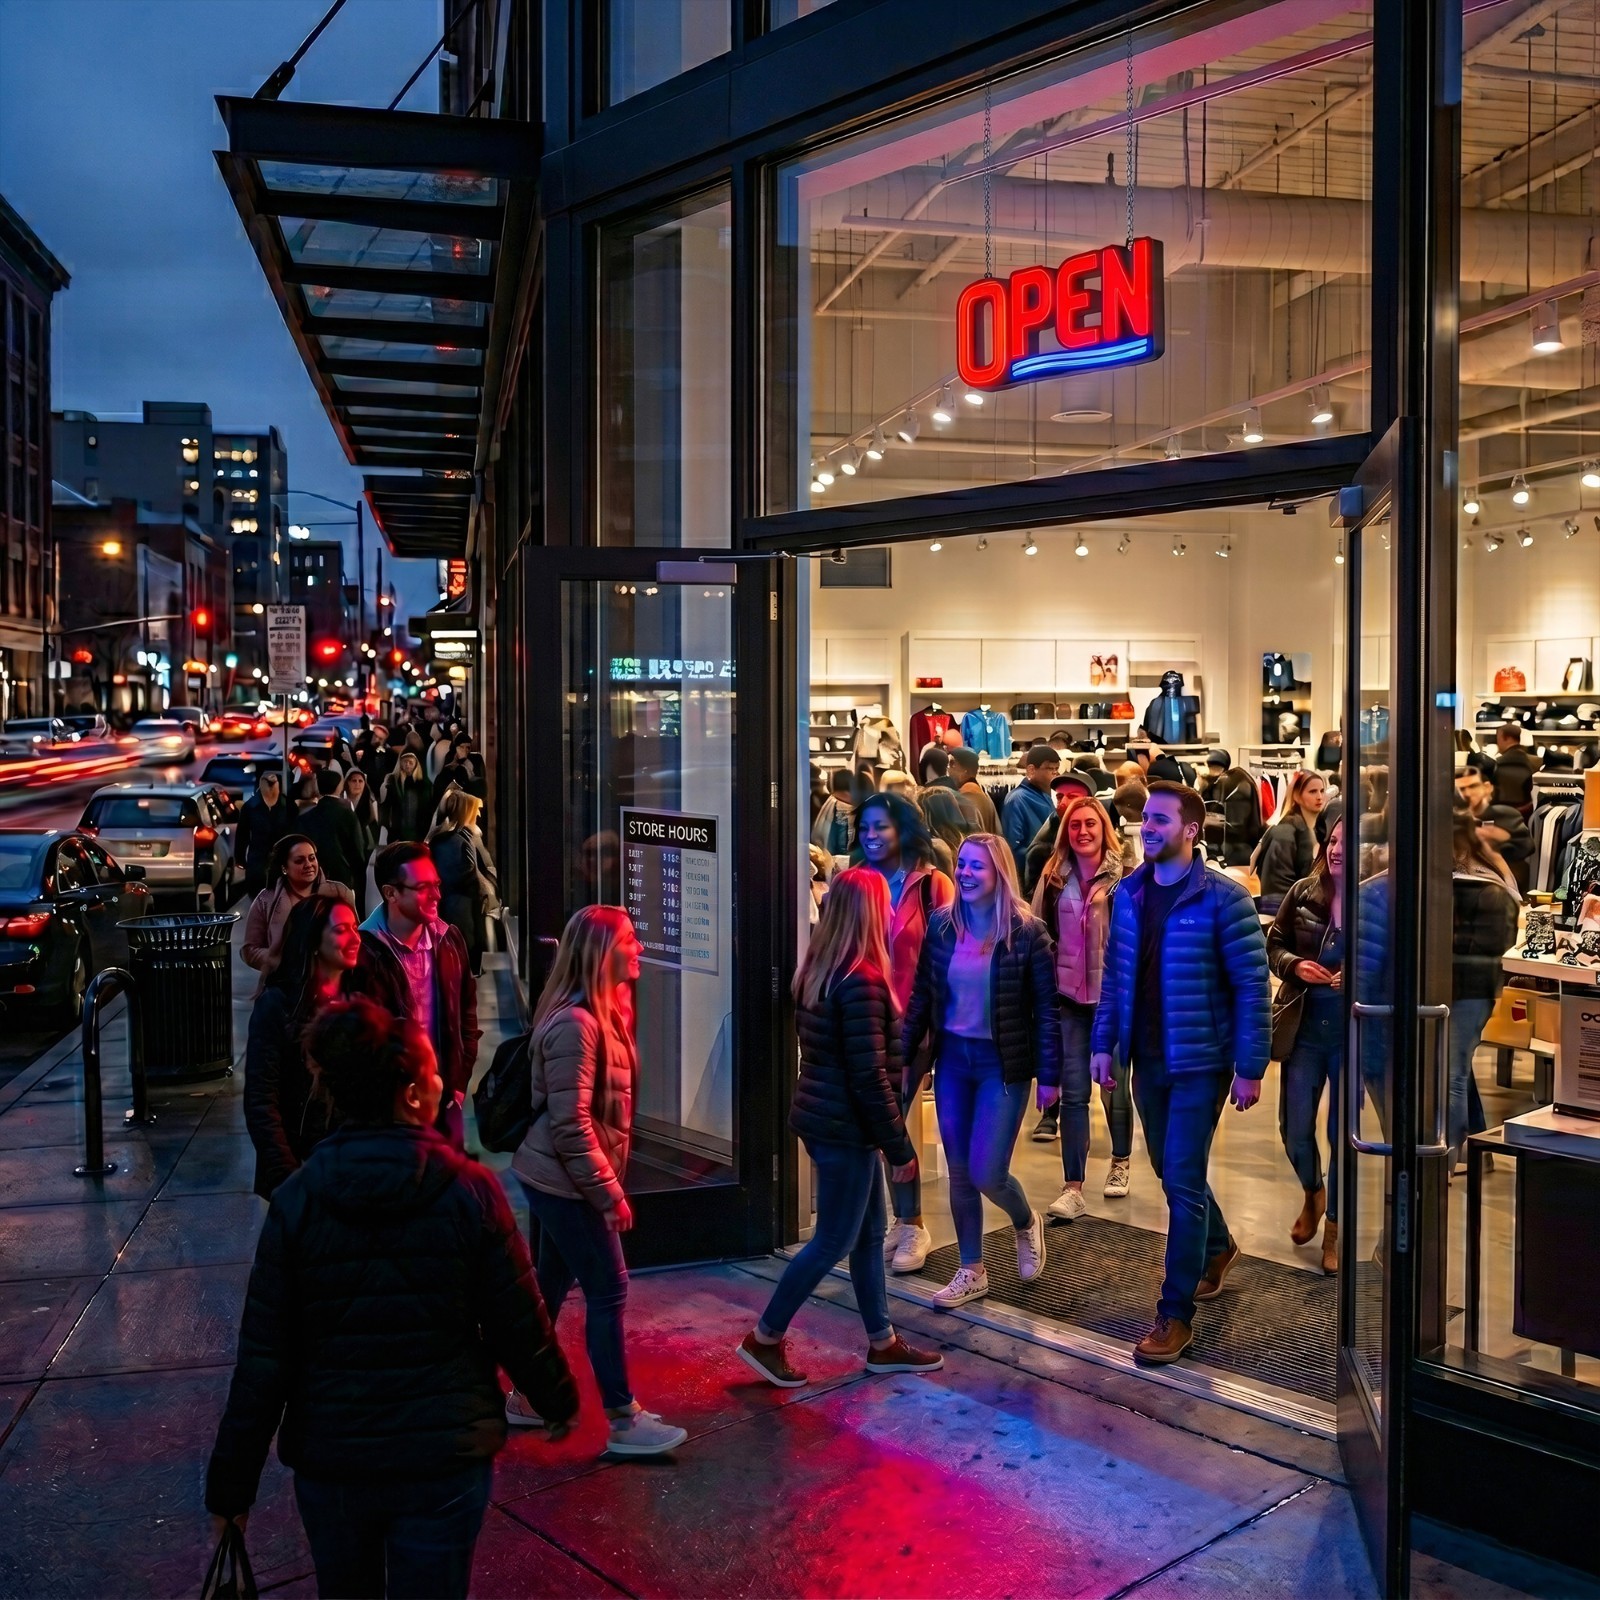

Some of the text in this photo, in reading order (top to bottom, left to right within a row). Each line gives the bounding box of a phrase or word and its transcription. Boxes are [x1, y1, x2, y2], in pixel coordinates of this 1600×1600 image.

[956, 236, 1153, 387] OPEN
[629, 820, 708, 843] STORE HOURS
